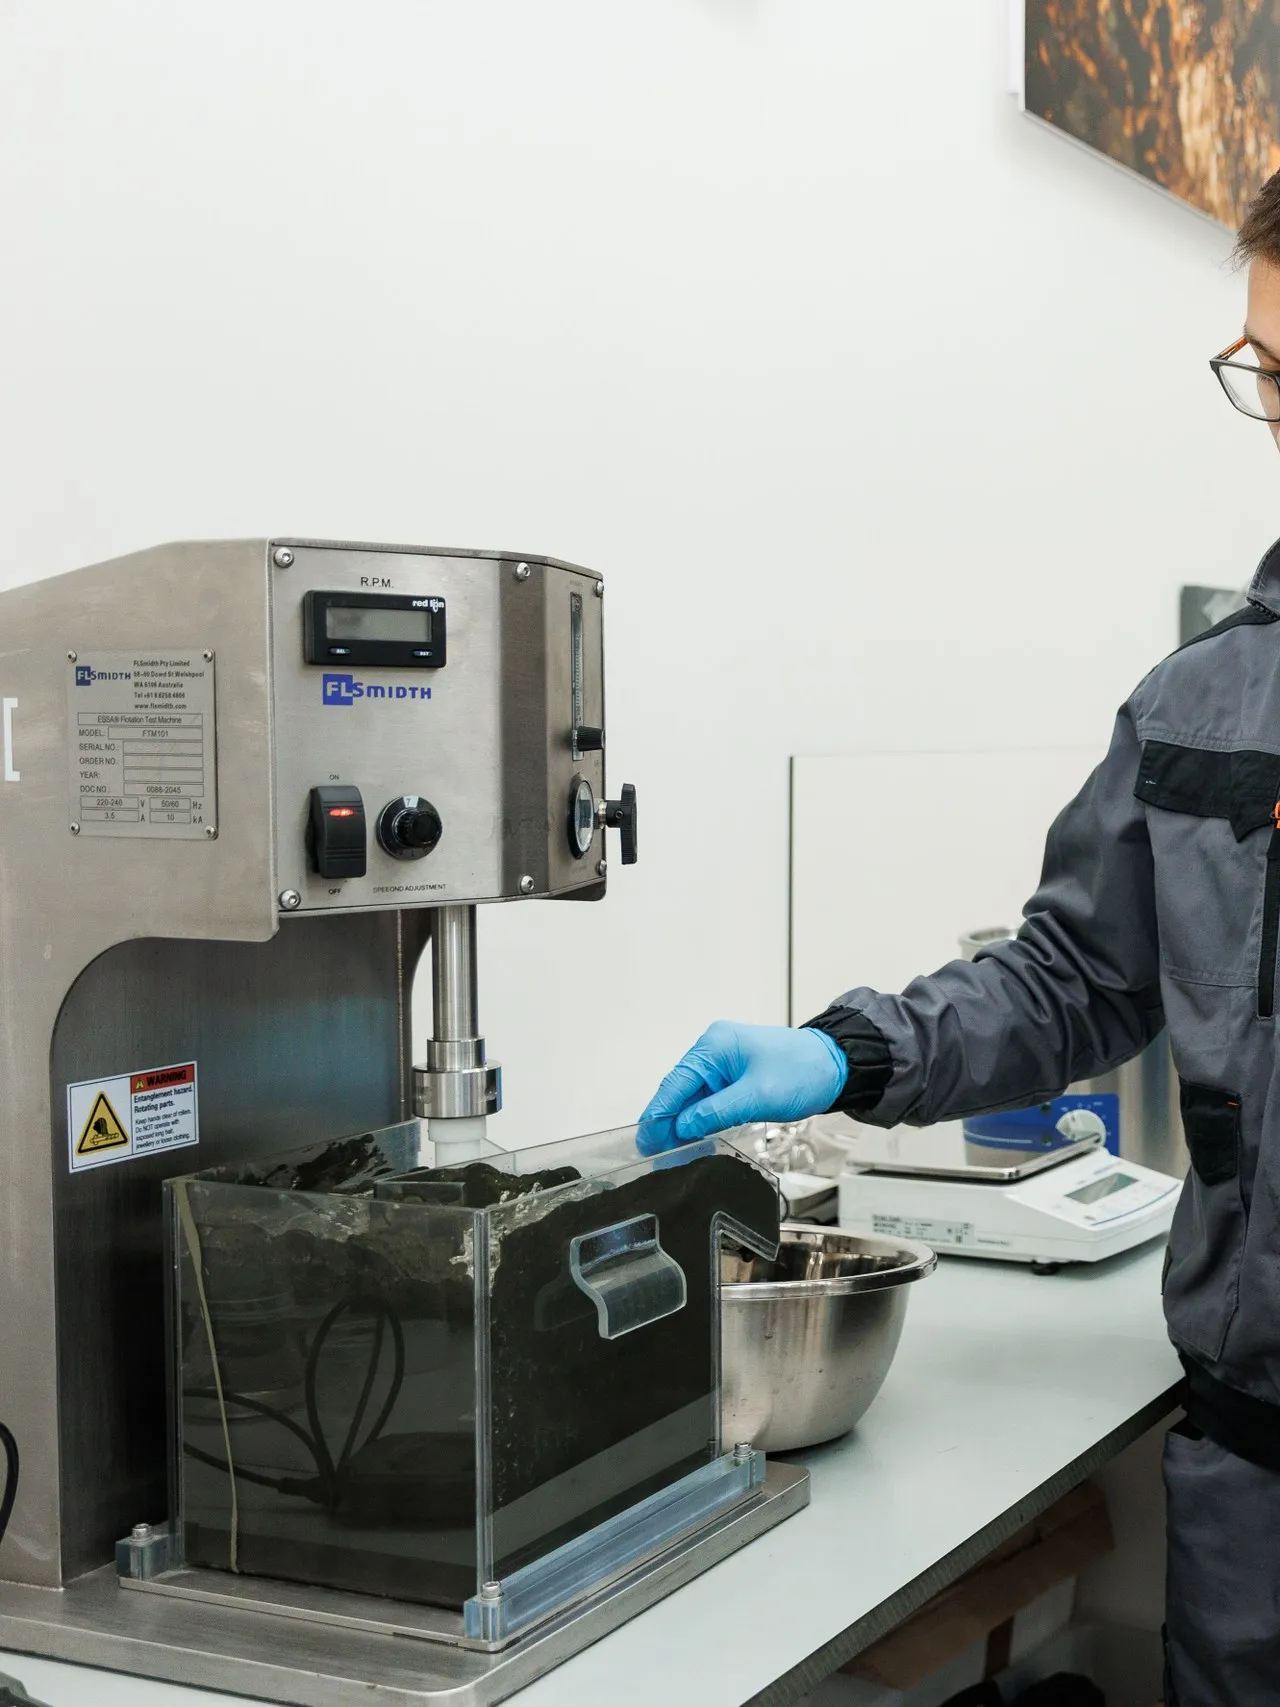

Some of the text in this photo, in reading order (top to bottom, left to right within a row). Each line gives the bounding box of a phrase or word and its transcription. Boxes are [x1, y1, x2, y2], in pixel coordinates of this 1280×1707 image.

[360, 577, 394, 588] R.P.M.
[430, 599, 444, 612] lion
[79, 729, 105, 737] MODEL:
[80, 743, 104, 751] SERIAL
[80, 757, 104, 765] ORDER
[193, 801, 202, 809] Hz
[141, 814, 145, 822] A
[146, 1070, 187, 1086] WARNING
[134, 1090, 172, 1103] Entanglement
[134, 1100, 175, 1113] Rotating parts.
[136, 1117, 147, 1125] Keep
[162, 1112, 172, 1120] clear
[154, 1121, 170, 1130] operate
[136, 1132, 154, 1141] exposed
[155, 1130, 164, 1138] long
[136, 1141, 154, 1150] jewellery
